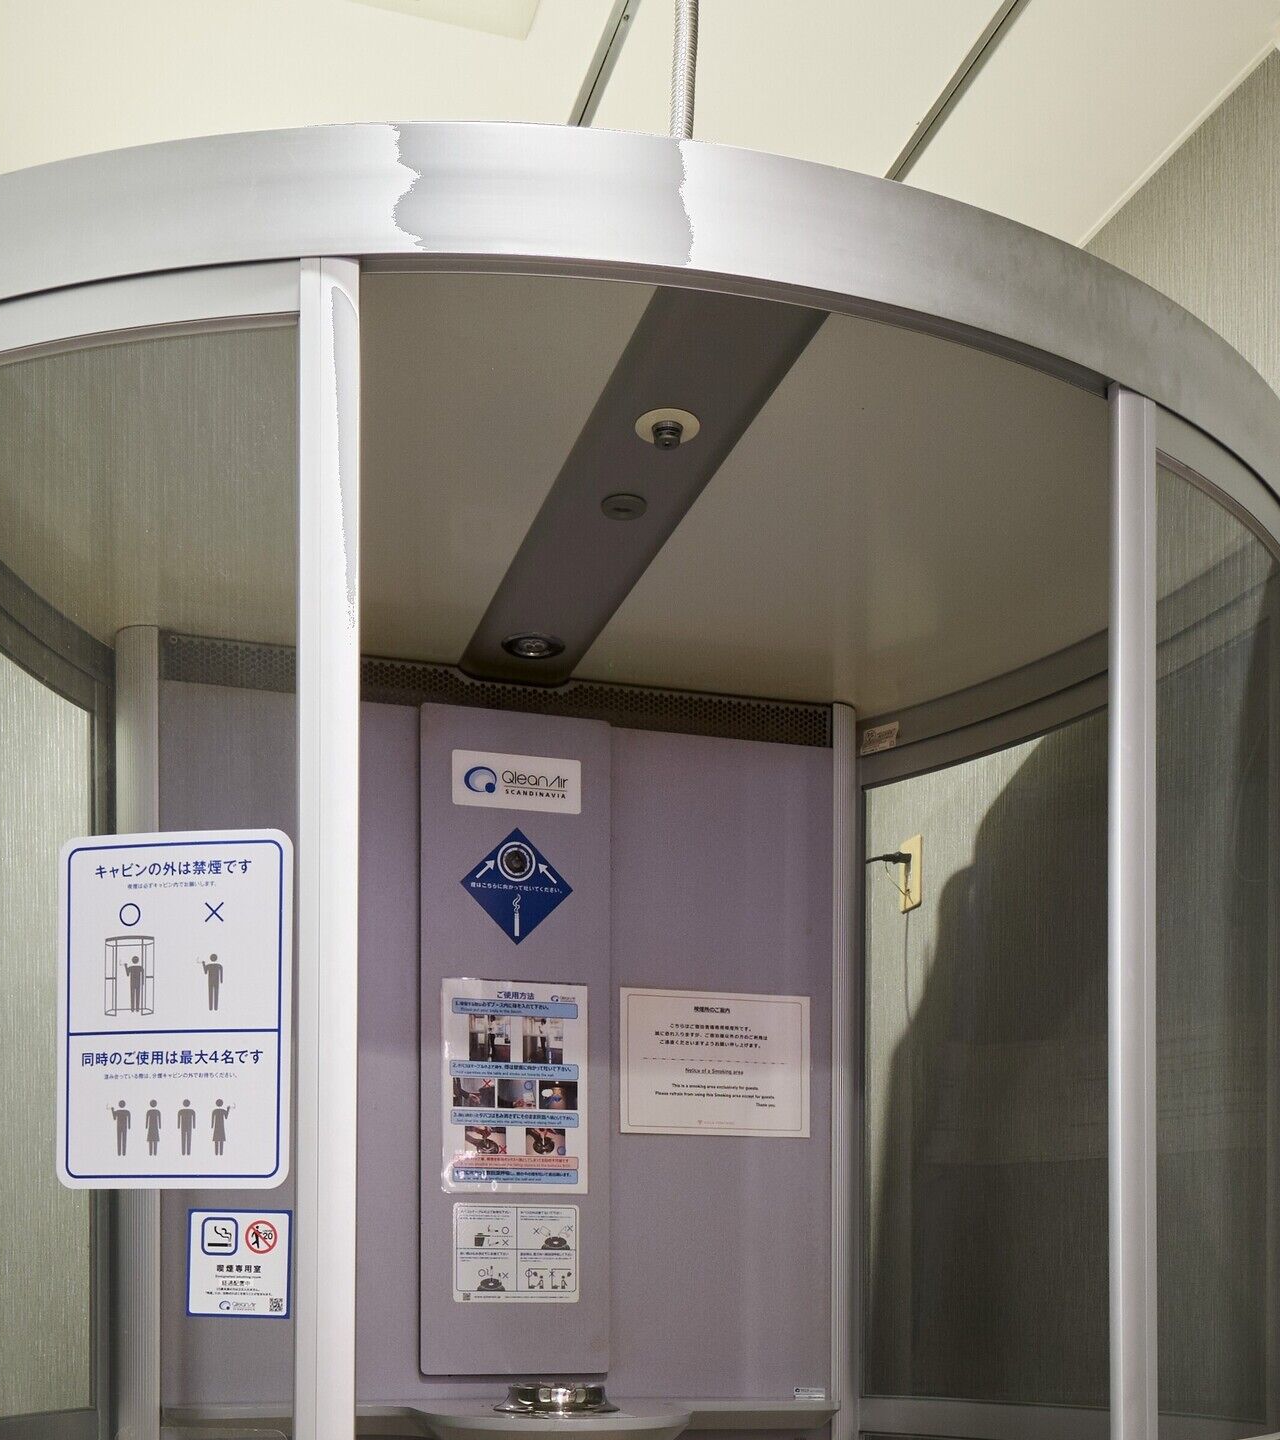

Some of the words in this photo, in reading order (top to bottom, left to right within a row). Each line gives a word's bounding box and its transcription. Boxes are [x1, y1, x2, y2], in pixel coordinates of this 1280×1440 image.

[504, 788, 566, 799] SCANDINAVIA
[94, 859, 252, 879] キャビンの外は禁煙です
[470, 882, 562, 893] 煙はこちらに向かって吐いてください。
[496, 991, 535, 1000] ご使用方法
[81, 1049, 263, 1067] 同時のご使用は最大4名です
[262, 1232, 273, 1240] 20
[216, 1264, 261, 1273] 喫煙専用室
